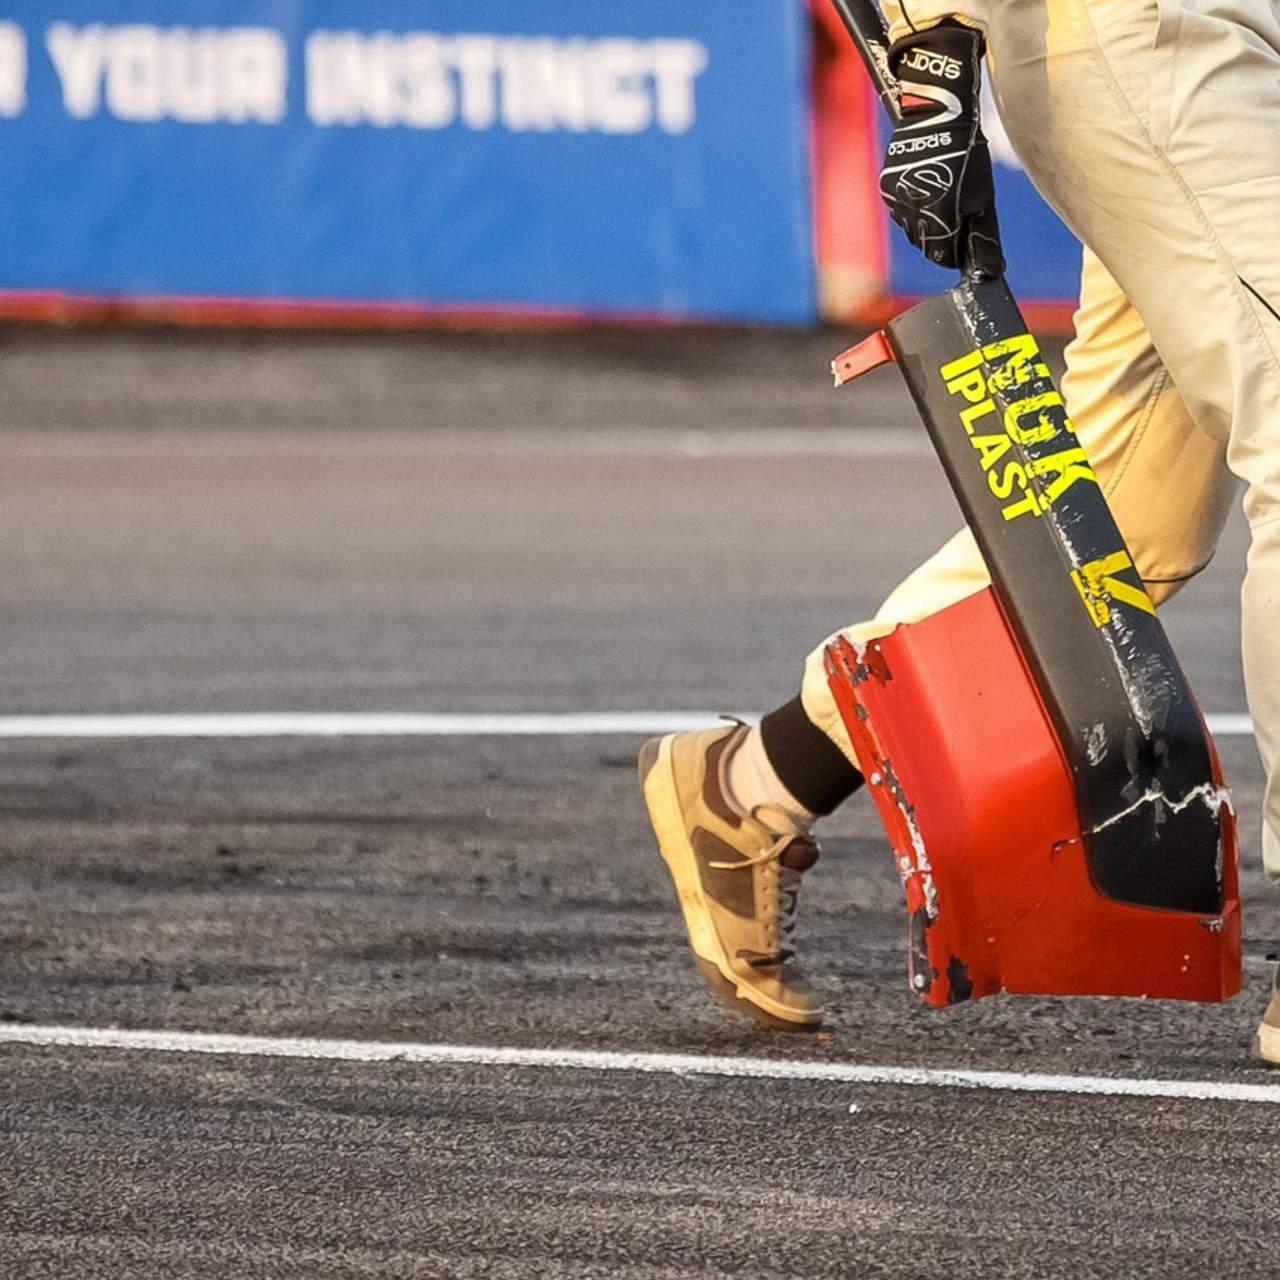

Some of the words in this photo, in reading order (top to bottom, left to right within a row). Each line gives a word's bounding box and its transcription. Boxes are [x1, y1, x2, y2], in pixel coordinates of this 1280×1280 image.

[47, 24, 287, 123] YOUR
[306, 30, 707, 133] INSTINCT
[901, 47, 963, 80] spar
